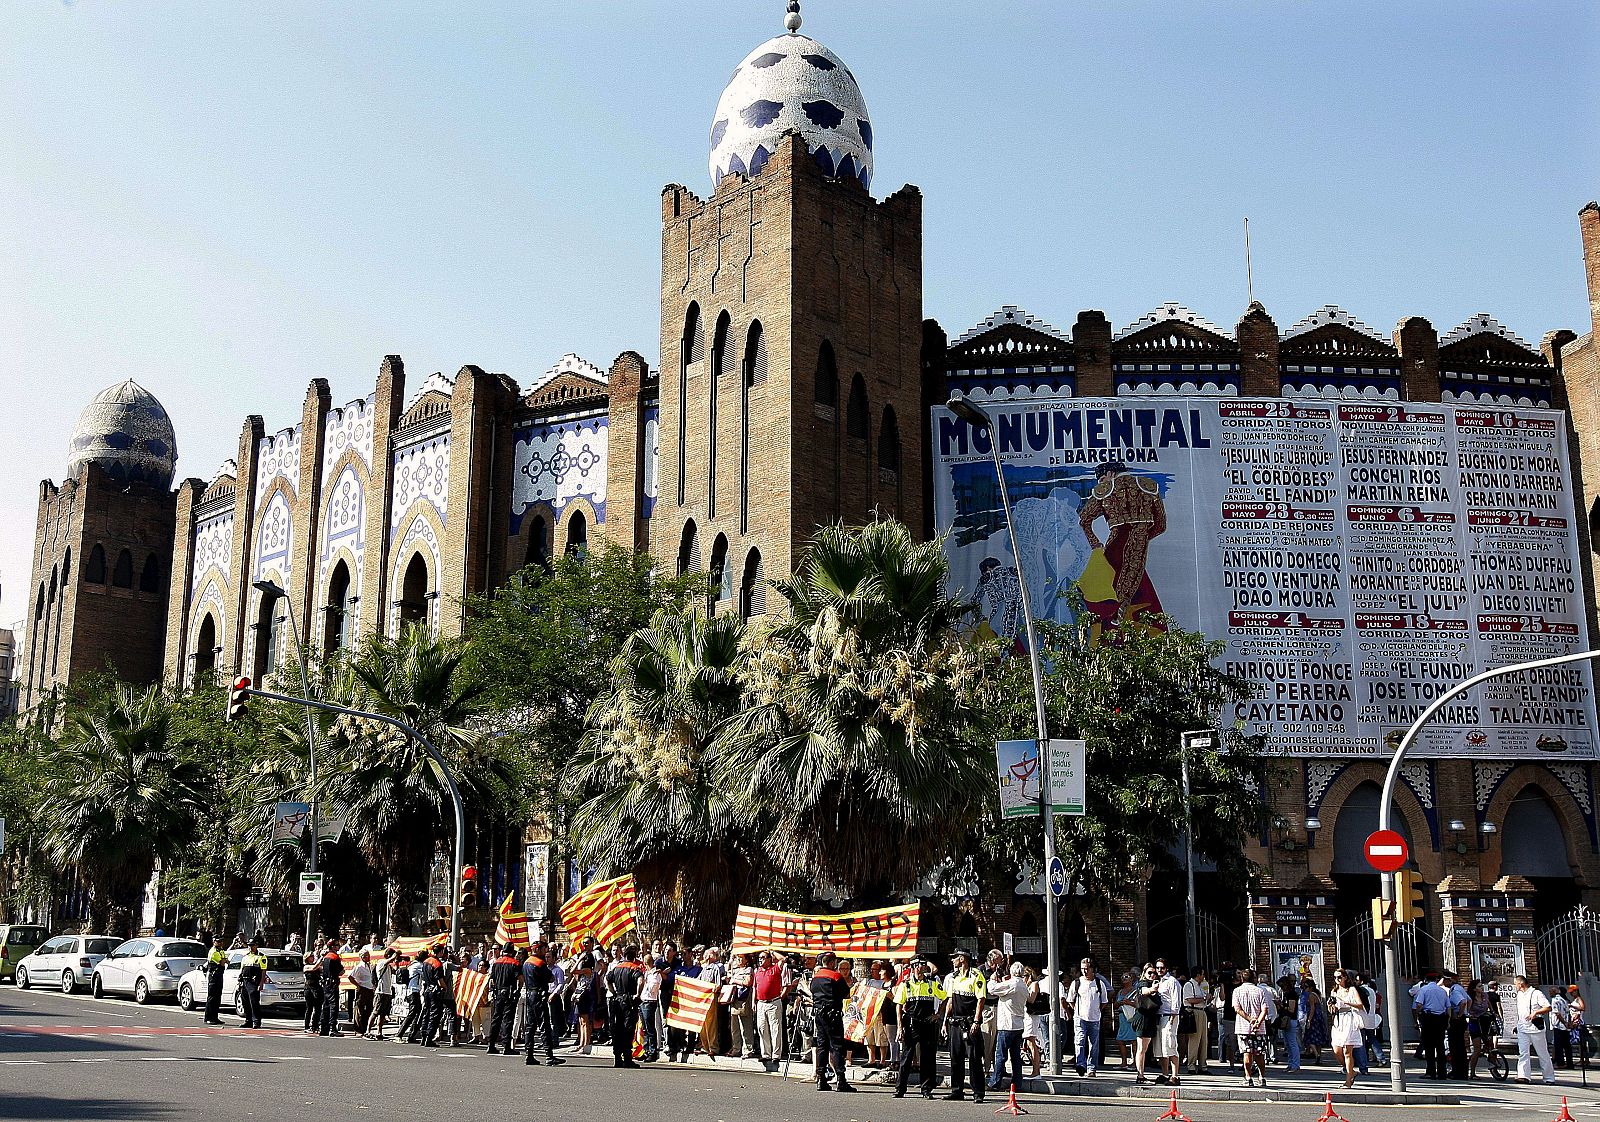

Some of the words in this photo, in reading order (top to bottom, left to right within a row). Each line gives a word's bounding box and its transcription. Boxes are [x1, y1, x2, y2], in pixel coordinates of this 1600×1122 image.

[1265, 403, 1290, 417] 25
[1387, 407, 1398, 422] 2
[1222, 420, 1272, 428] CORRIDA
[1277, 420, 1291, 428] DE
[1294, 421, 1331, 429] TOROS
[1493, 413, 1513, 427] 16
[939, 409, 1211, 456] MONUMENTAL
[1458, 427, 1503, 436] CORRIDA
[1507, 429, 1518, 437] DE
[1523, 430, 1556, 438] TOROS
[1064, 449, 1158, 464] BARCELONA
[1221, 448, 1270, 467] "JESULIN
[1274, 452, 1284, 463] DE
[1288, 452, 1334, 468] UBRIQUE"
[1342, 449, 1374, 467] JESUS
[1379, 450, 1449, 467] FERNANDEZ
[1459, 454, 1507, 470] EUGENIO
[1511, 456, 1524, 471] DE
[1528, 457, 1561, 473] MORA
[1224, 470, 1248, 485] "EL
[1252, 470, 1334, 487] CORDOBES"
[1351, 468, 1404, 483] CONCHI
[1410, 470, 1441, 485] RIOS
[1460, 473, 1511, 489] ANTONIO
[1514, 475, 1563, 492] BARRERA
[1257, 488, 1281, 502] "EL
[1286, 489, 1337, 503] FANDI"
[1347, 485, 1402, 501] MARTIN
[1408, 486, 1450, 502] REINA
[1466, 491, 1516, 507] SERAFIN
[1519, 493, 1557, 509] MARIN
[1265, 503, 1289, 518] 23
[1398, 508, 1415, 522] 6
[1508, 511, 1530, 525] 27
[1221, 521, 1270, 529] CORRIDA
[1273, 522, 1286, 530] DE
[1290, 522, 1334, 532] REJONES
[1351, 523, 1398, 531] CORRIDA
[1401, 524, 1415, 532] DE
[1486, 542, 1554, 551] "YERBABUENA"
[1223, 551, 1283, 568] ANTONIO
[1287, 552, 1341, 573] DOMECQ
[1350, 556, 1392, 573] "FINITO
[1396, 563, 1405, 573] DE
[1409, 558, 1465, 574] CORDOBA"
[1471, 555, 1522, 571] THOMAS
[1526, 557, 1572, 574] DUFFAU
[1224, 571, 1267, 588] DIEGO
[1272, 572, 1340, 590] VENTURA
[1351, 575, 1409, 591] MORANTE
[1422, 576, 1467, 592] PUEBLA
[1473, 575, 1504, 595] JUAN
[1509, 575, 1530, 591] DEL
[1534, 576, 1575, 593] ALAMO
[1233, 590, 1272, 610] JOAO
[1279, 591, 1336, 608] MOURA
[1389, 594, 1418, 610] "EL
[1424, 595, 1466, 615] JULI"
[1483, 595, 1520, 611] DIEGO
[1525, 597, 1567, 613] SILVETI
[1284, 613, 1302, 627] 4
[1404, 615, 1430, 629] 18
[1520, 617, 1542, 631] 25
[1228, 628, 1281, 637] CORRIDA
[1285, 629, 1300, 637] DE
[1303, 629, 1342, 637] TOROS
[1546, 636, 1580, 644] TOROS
[1287, 641, 1331, 649] LORENZO
[1226, 662, 1297, 682] ENRIQUE
[1302, 663, 1352, 680] PONCE
[1276, 683, 1352, 701] PERERA
[1235, 703, 1344, 721] CAYETANO
[1490, 707, 1586, 725] TALAVANTE
[1253, 724, 1276, 733] Telf.
[1283, 724, 1302, 733] 902
[1306, 724, 1324, 733] 109
[1327, 724, 1345, 733] 548
[1264, 735, 1378, 745] cionestaurinas.com
